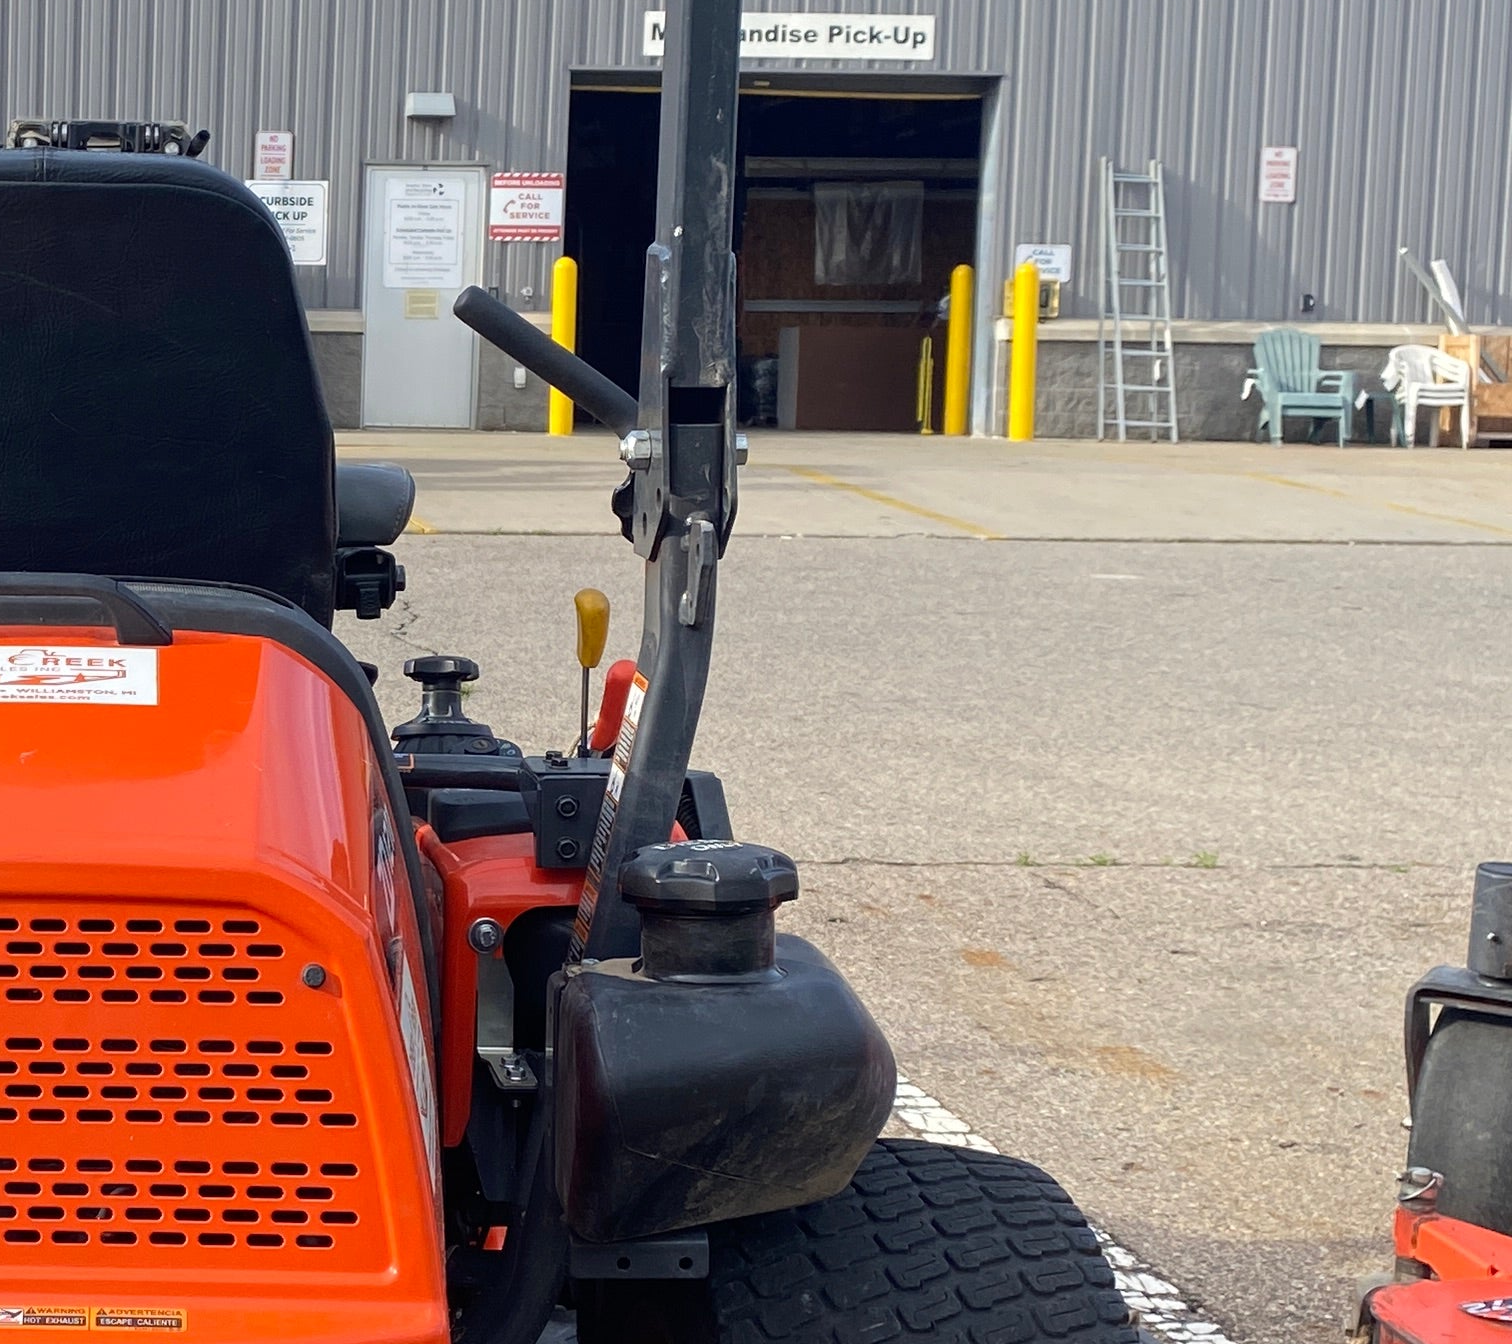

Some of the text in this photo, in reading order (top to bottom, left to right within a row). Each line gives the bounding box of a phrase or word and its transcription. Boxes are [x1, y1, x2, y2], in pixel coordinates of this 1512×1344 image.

[828, 24, 927, 49] Pick-Up
[260, 144, 287, 152] PARKING
[260, 157, 286, 165] LOADING
[264, 166, 281, 174] ZONE
[518, 193, 544, 201] CALL
[520, 202, 541, 210] FOR
[292, 211, 308, 221] UP
[509, 211, 551, 220] SERVICE
[16, 688, 118, 696] WILLIAMSTON,
[37, 1307, 183, 1317] WARNING ADVERTENCIA
[45, 1317, 85, 1325] EXHAUST
[100, 1317, 178, 1327] ESCAPE CALIENTE
